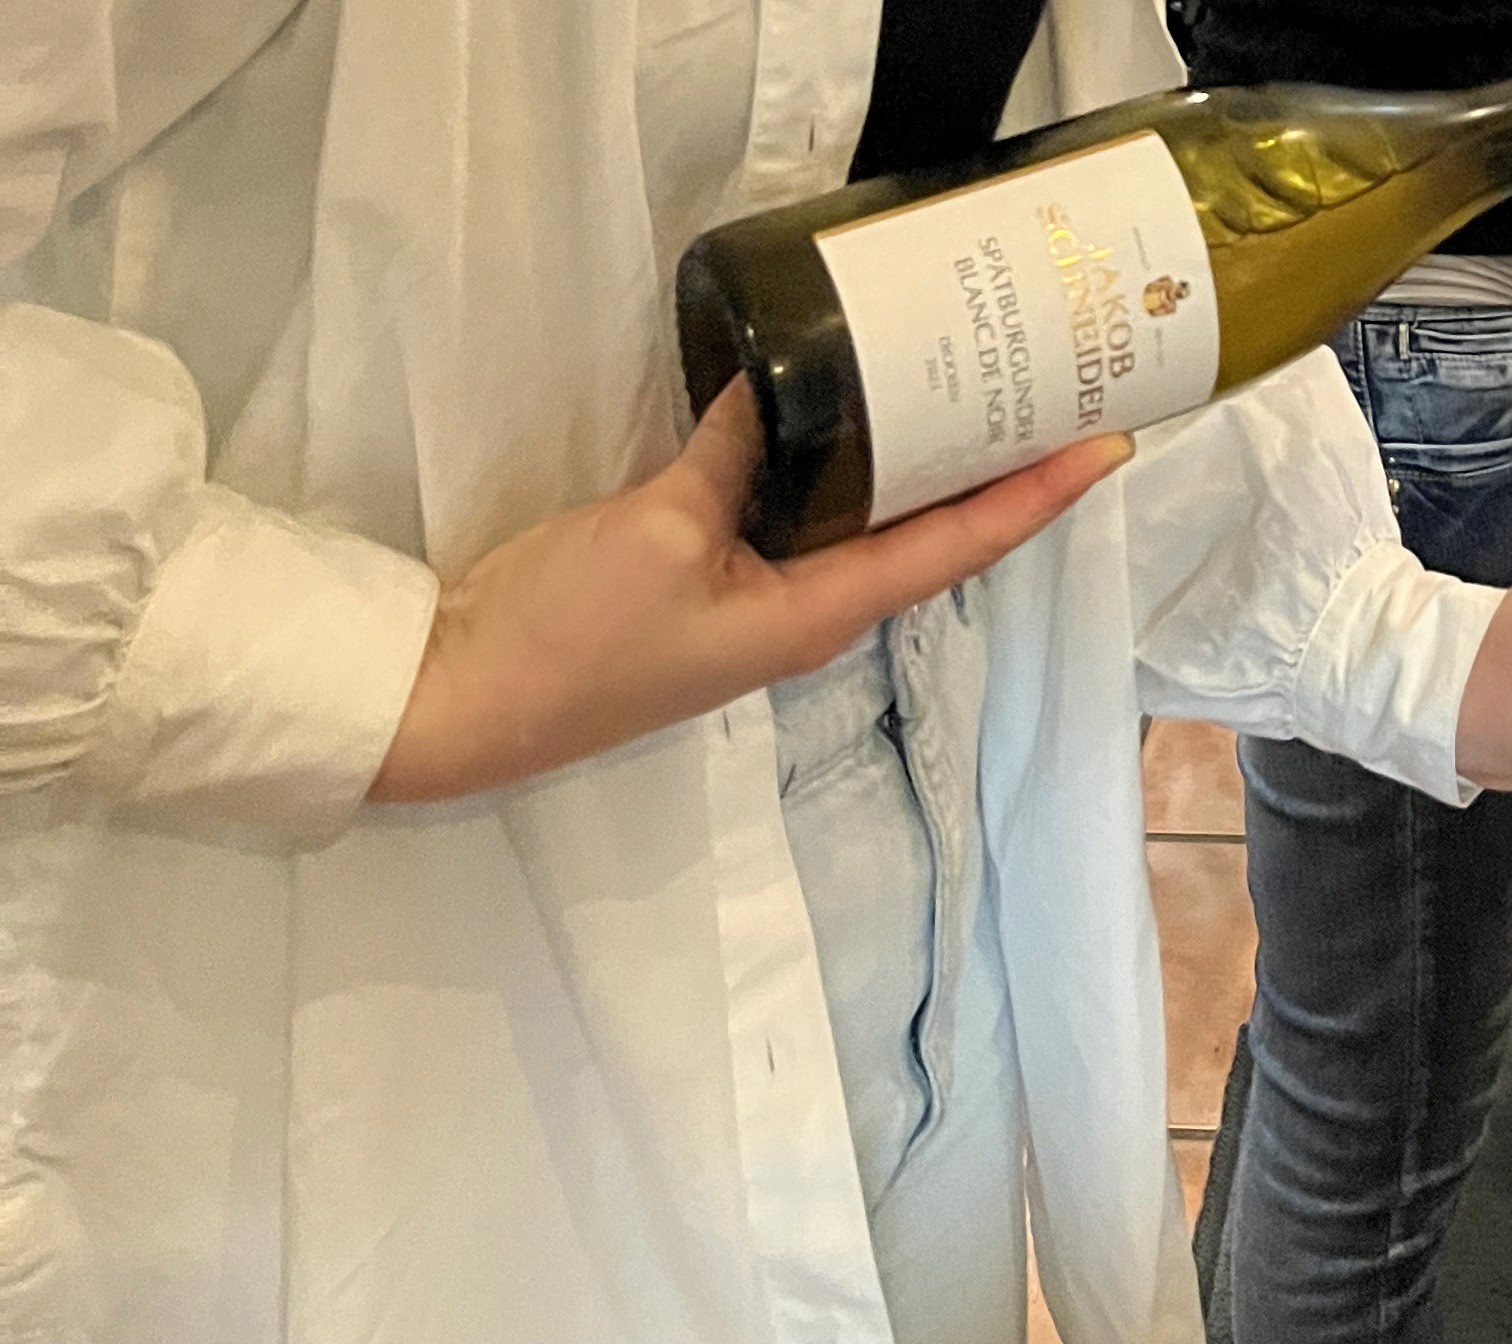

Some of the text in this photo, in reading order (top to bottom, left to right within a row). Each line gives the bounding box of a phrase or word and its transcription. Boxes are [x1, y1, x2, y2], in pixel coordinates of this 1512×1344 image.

[954, 256, 1006, 445] BLANC DE NOIR
[1086, 244, 1136, 379] JAKOB
